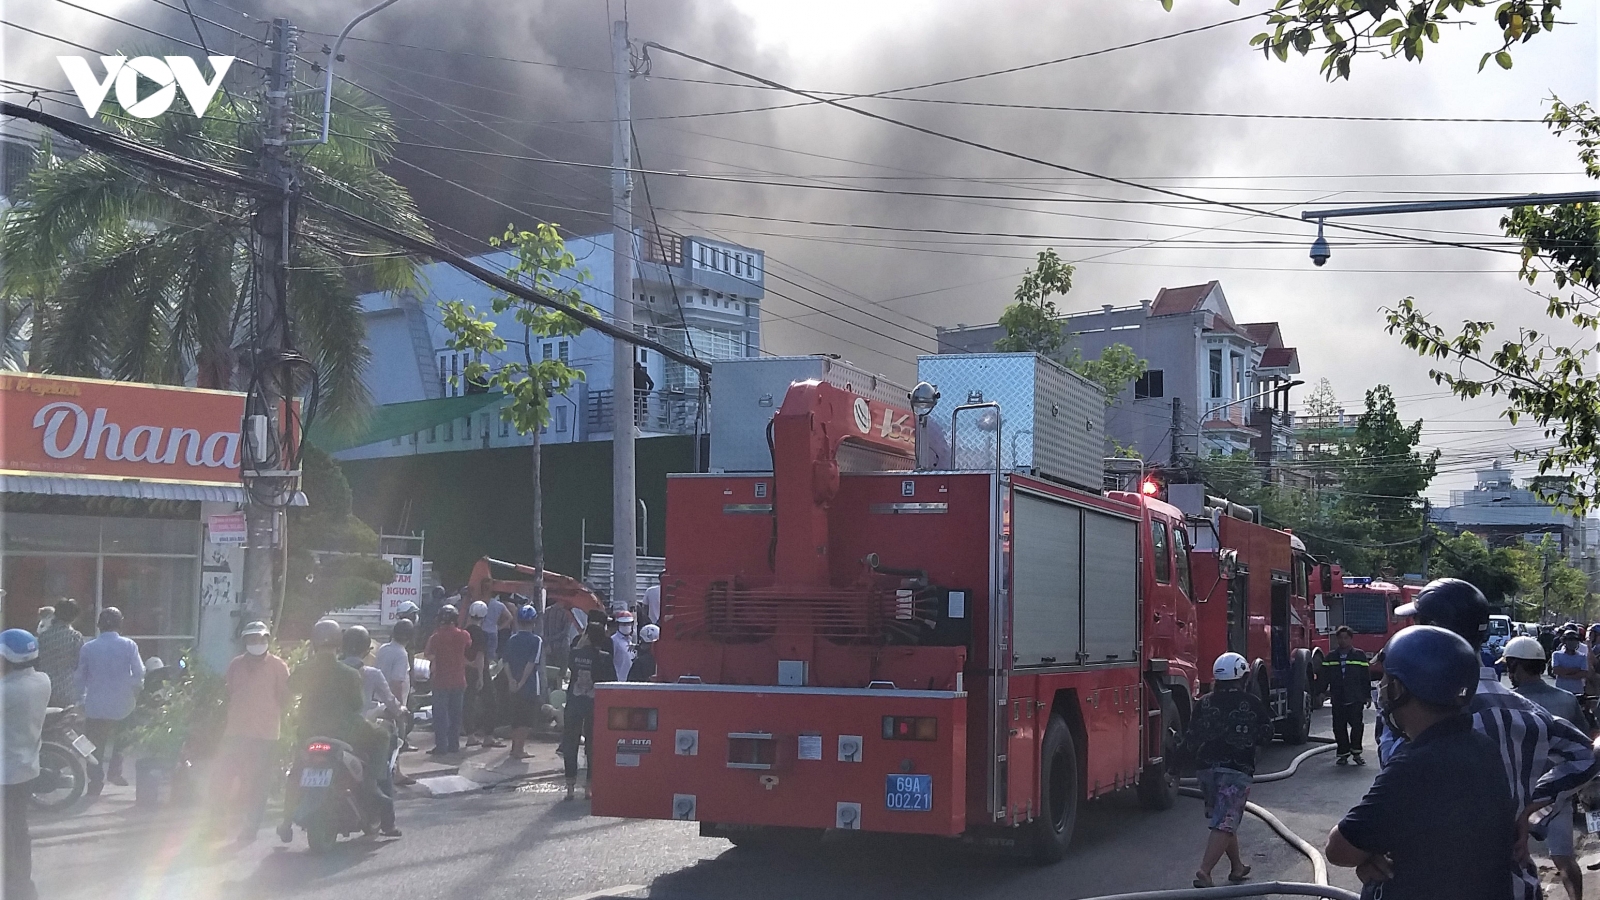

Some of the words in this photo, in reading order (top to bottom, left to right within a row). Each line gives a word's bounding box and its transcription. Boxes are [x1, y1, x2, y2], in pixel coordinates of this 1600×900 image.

[33, 401, 241, 468] Ohana
[896, 777, 920, 792] 69A
[887, 793, 928, 809] 002.21
